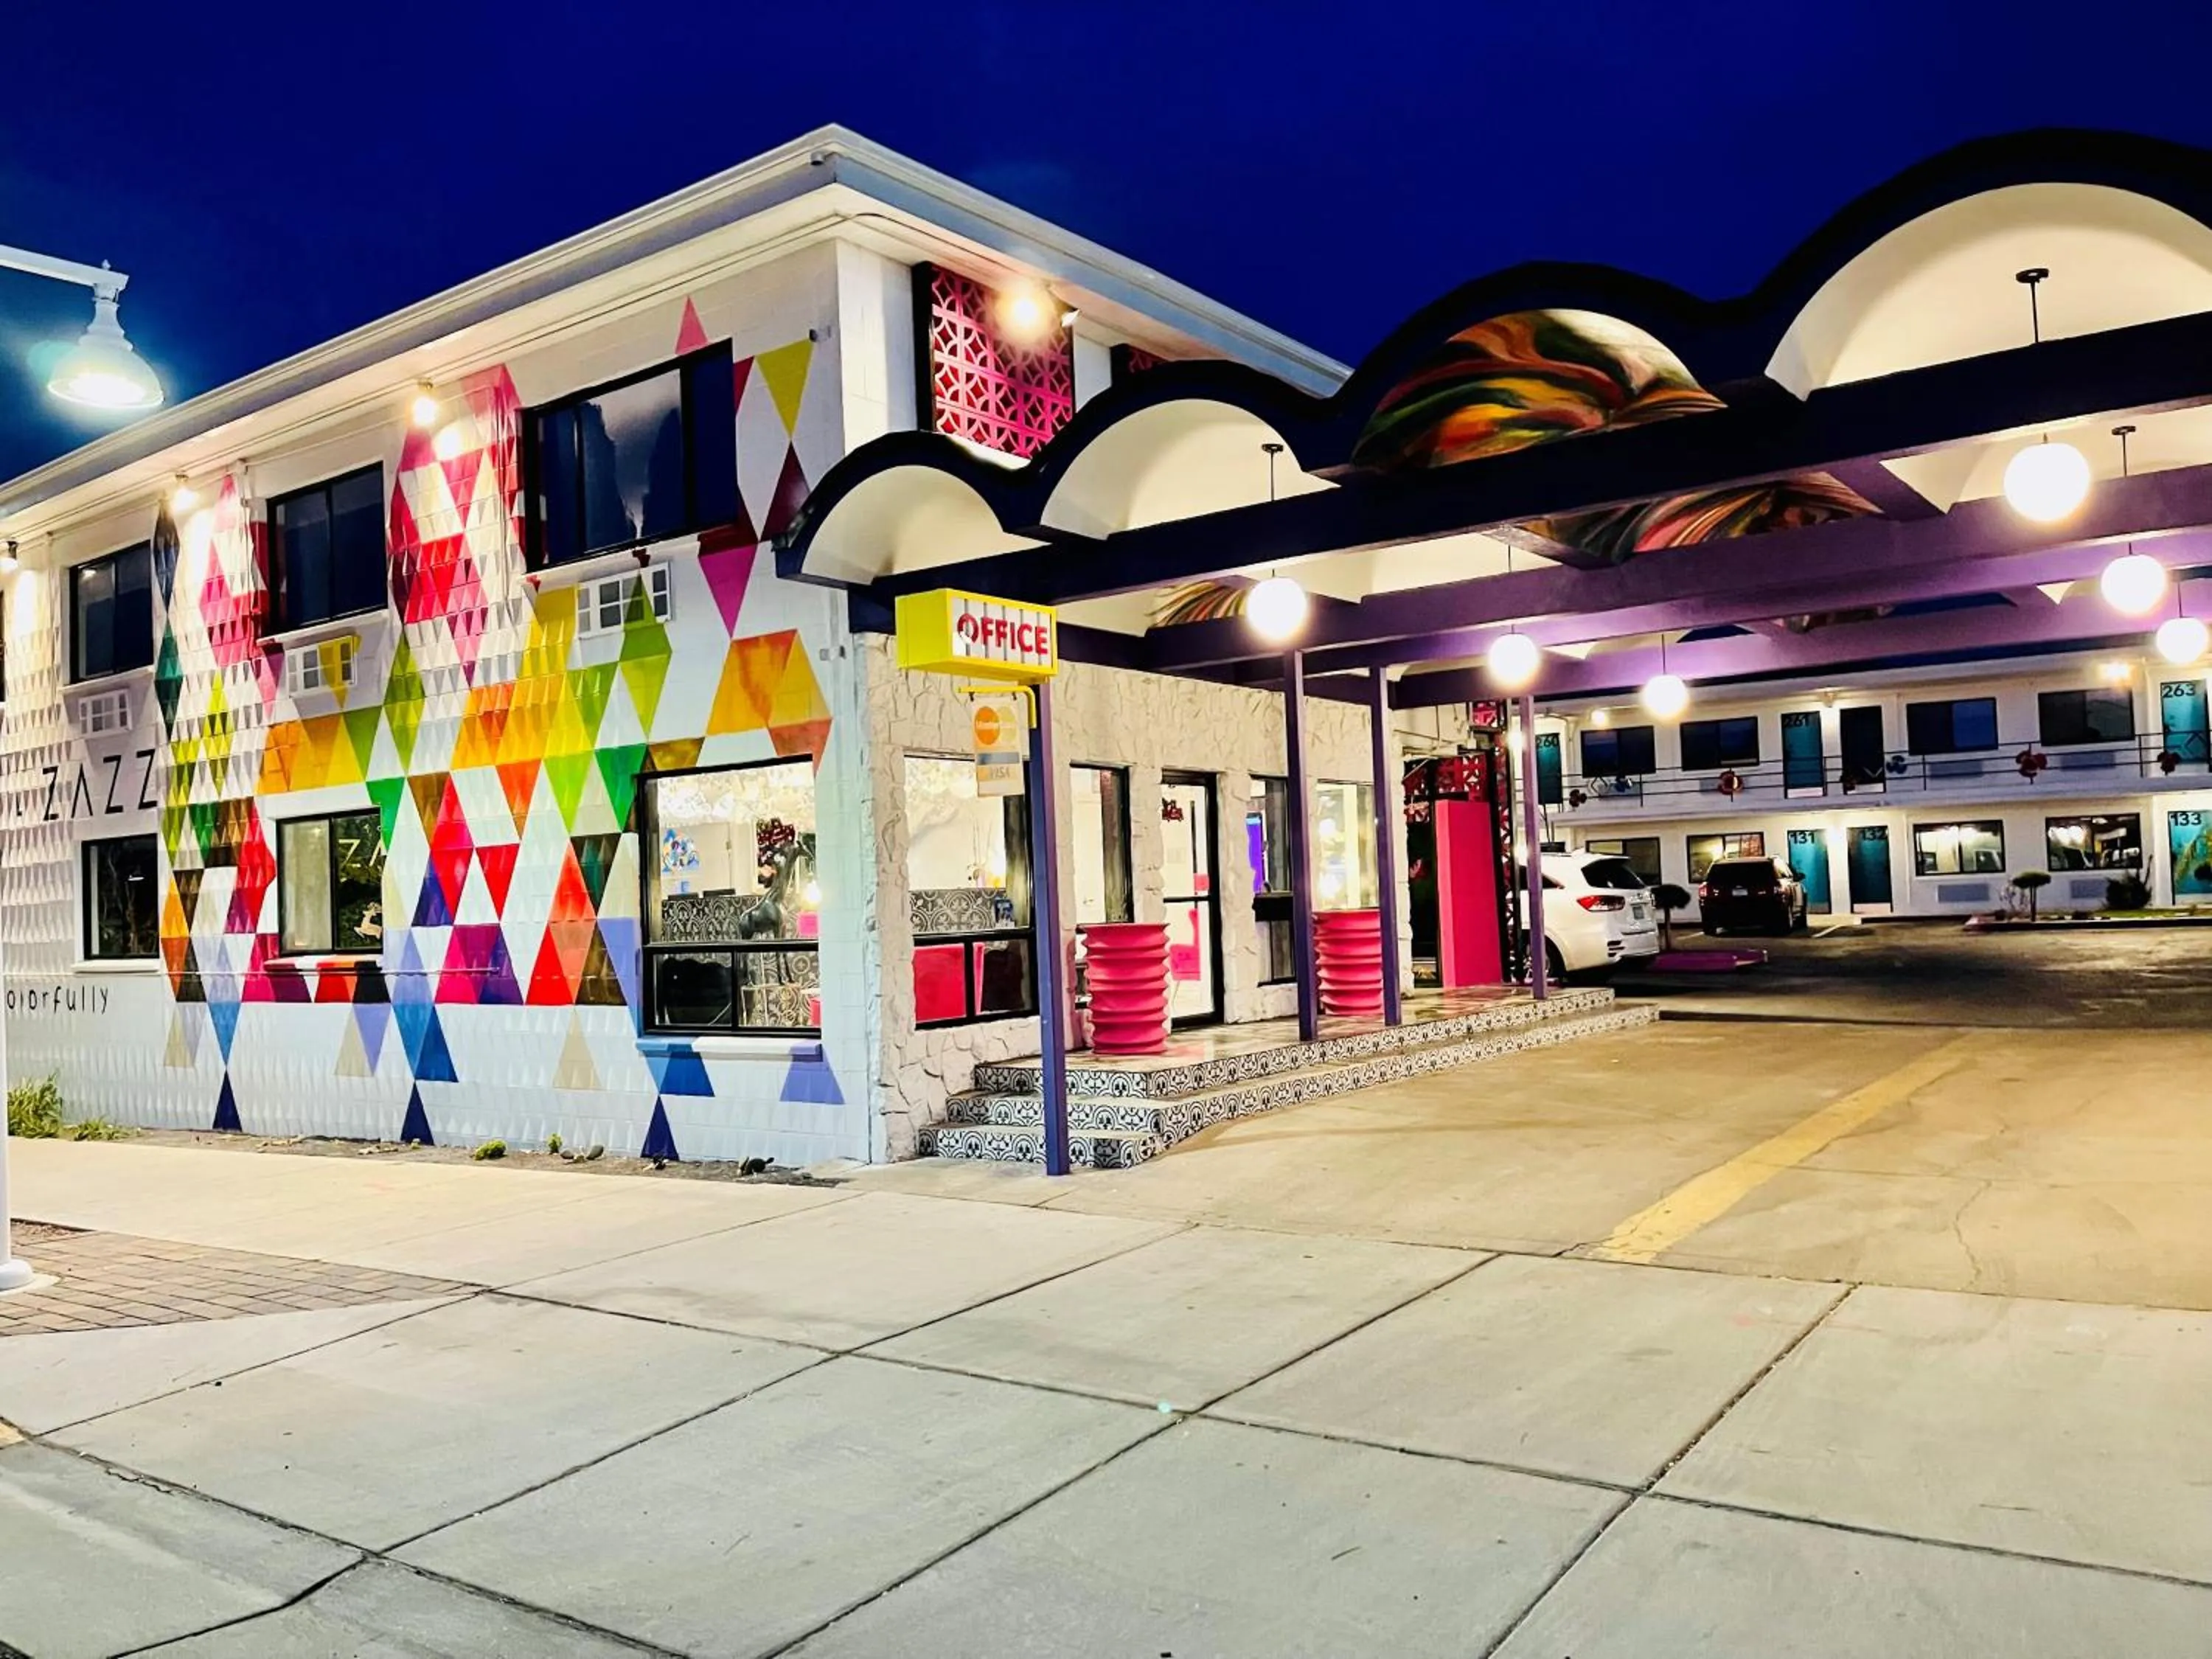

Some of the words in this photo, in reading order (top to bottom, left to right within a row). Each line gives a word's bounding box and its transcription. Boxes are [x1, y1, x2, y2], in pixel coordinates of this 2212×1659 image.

[957, 613, 1048, 655] OFFICE
[2163, 684, 2196, 698] 263
[1784, 714, 1809, 728] 261
[43, 749, 158, 821] ZAZZ
[2171, 812, 2202, 827] 133
[1790, 831, 1815, 844] 131
[1860, 827, 1886, 841] 132
